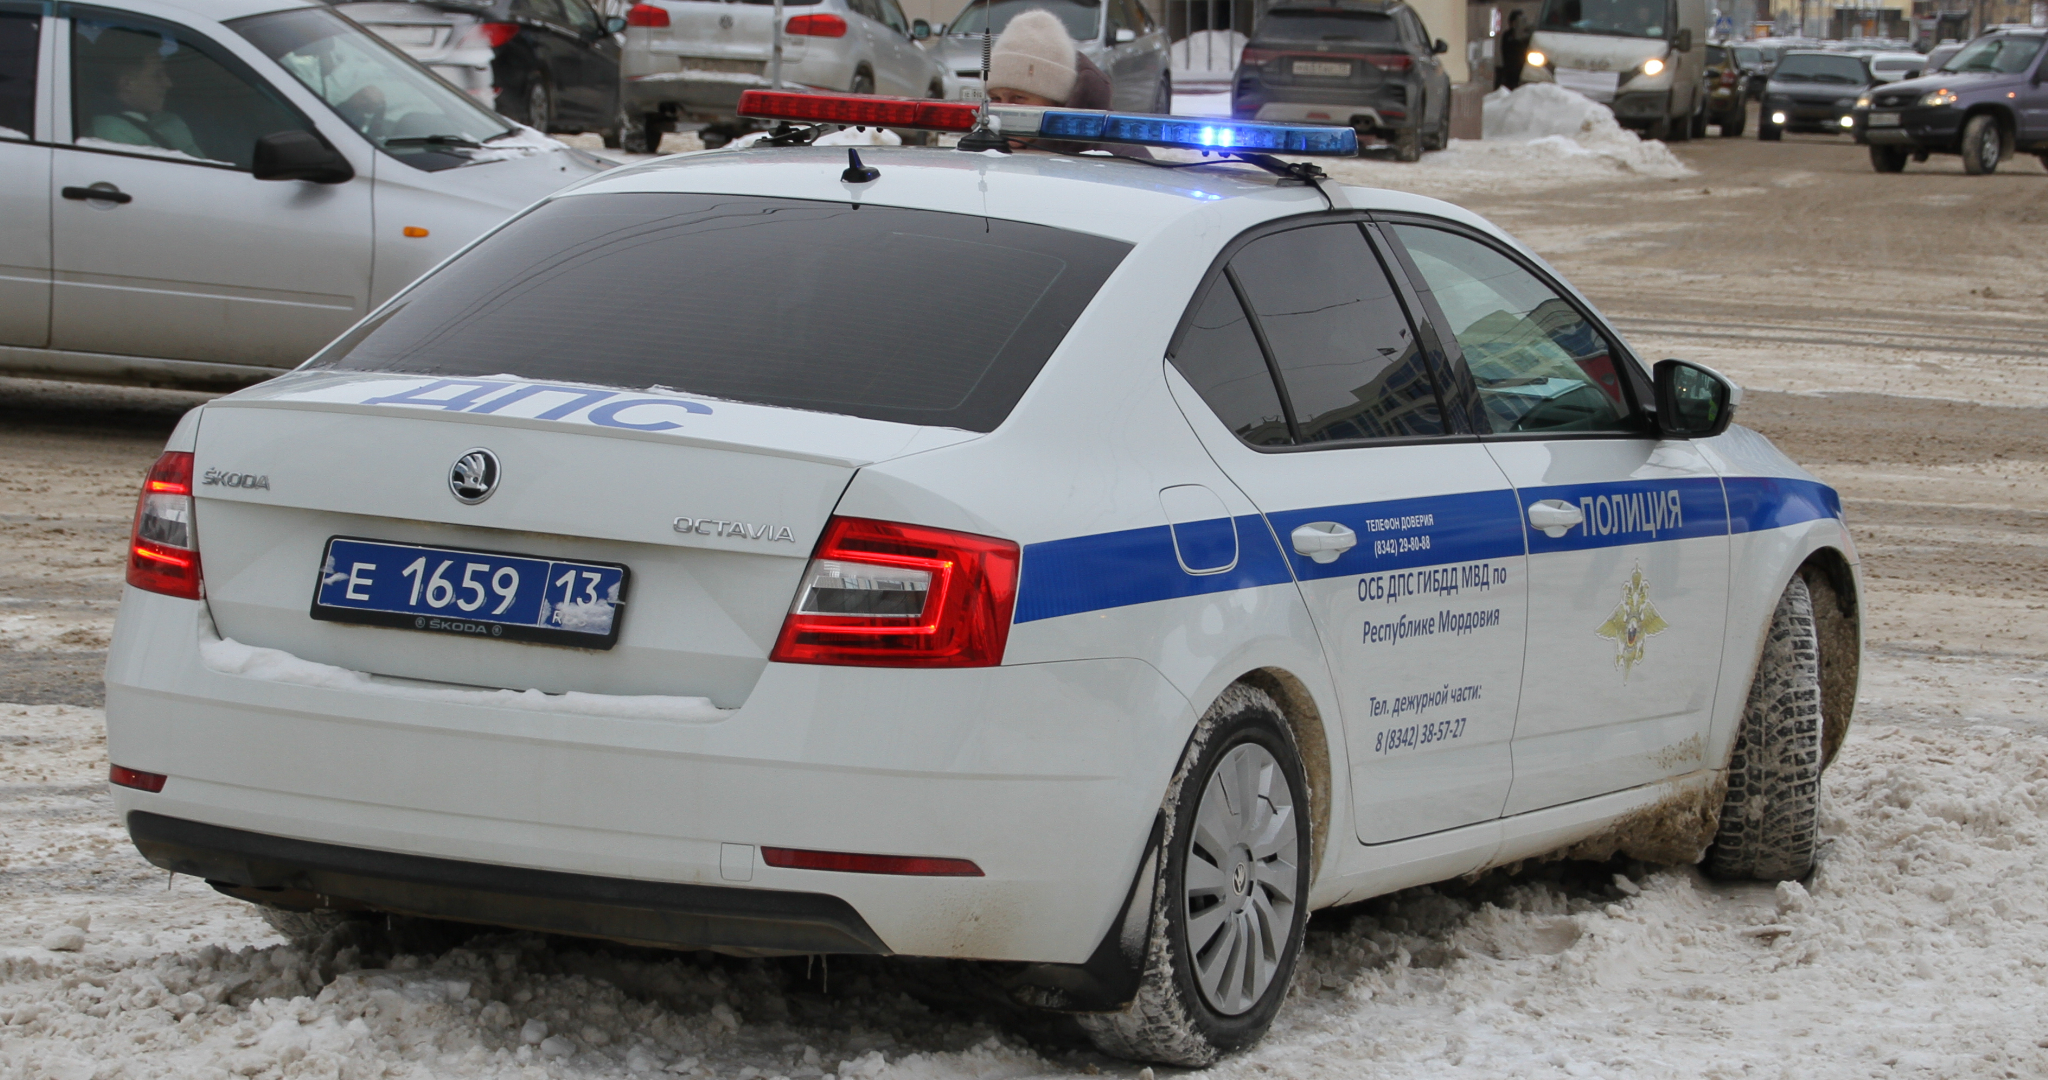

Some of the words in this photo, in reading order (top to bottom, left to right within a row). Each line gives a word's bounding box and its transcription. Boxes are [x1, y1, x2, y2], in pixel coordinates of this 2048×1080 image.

[359, 378, 714, 432] ДПС
[673, 516, 796, 543] OCTAVIA
[1365, 517, 1400, 533] ТЕЛЕФОН
[1401, 514, 1434, 531] ДОВЕРИЯ
[1580, 489, 1683, 539] ПОЛИЦИЯ
[1374, 539, 1398, 558] (8342)
[1399, 535, 1431, 553] 29-80-88
[401, 556, 520, 615] 1659
[555, 569, 602, 608] 13
[1358, 576, 1384, 602] ОСБ
[1387, 572, 1414, 604] ДПС
[1417, 567, 1458, 596] ГИБДД
[1461, 563, 1490, 592] МВД
[1492, 567, 1507, 585] по
[429, 618, 487, 634] ŠKODA
[1363, 614, 1435, 645] Республике
[1438, 609, 1500, 636] Мордовия
[1369, 697, 1390, 717] Тел.
[1391, 684, 1449, 718] дежурной
[1450, 684, 1482, 703] части:
[1375, 731, 1383, 752] 8
[1384, 724, 1419, 755] (8342)
[1420, 718, 1467, 744] 38-57-27
